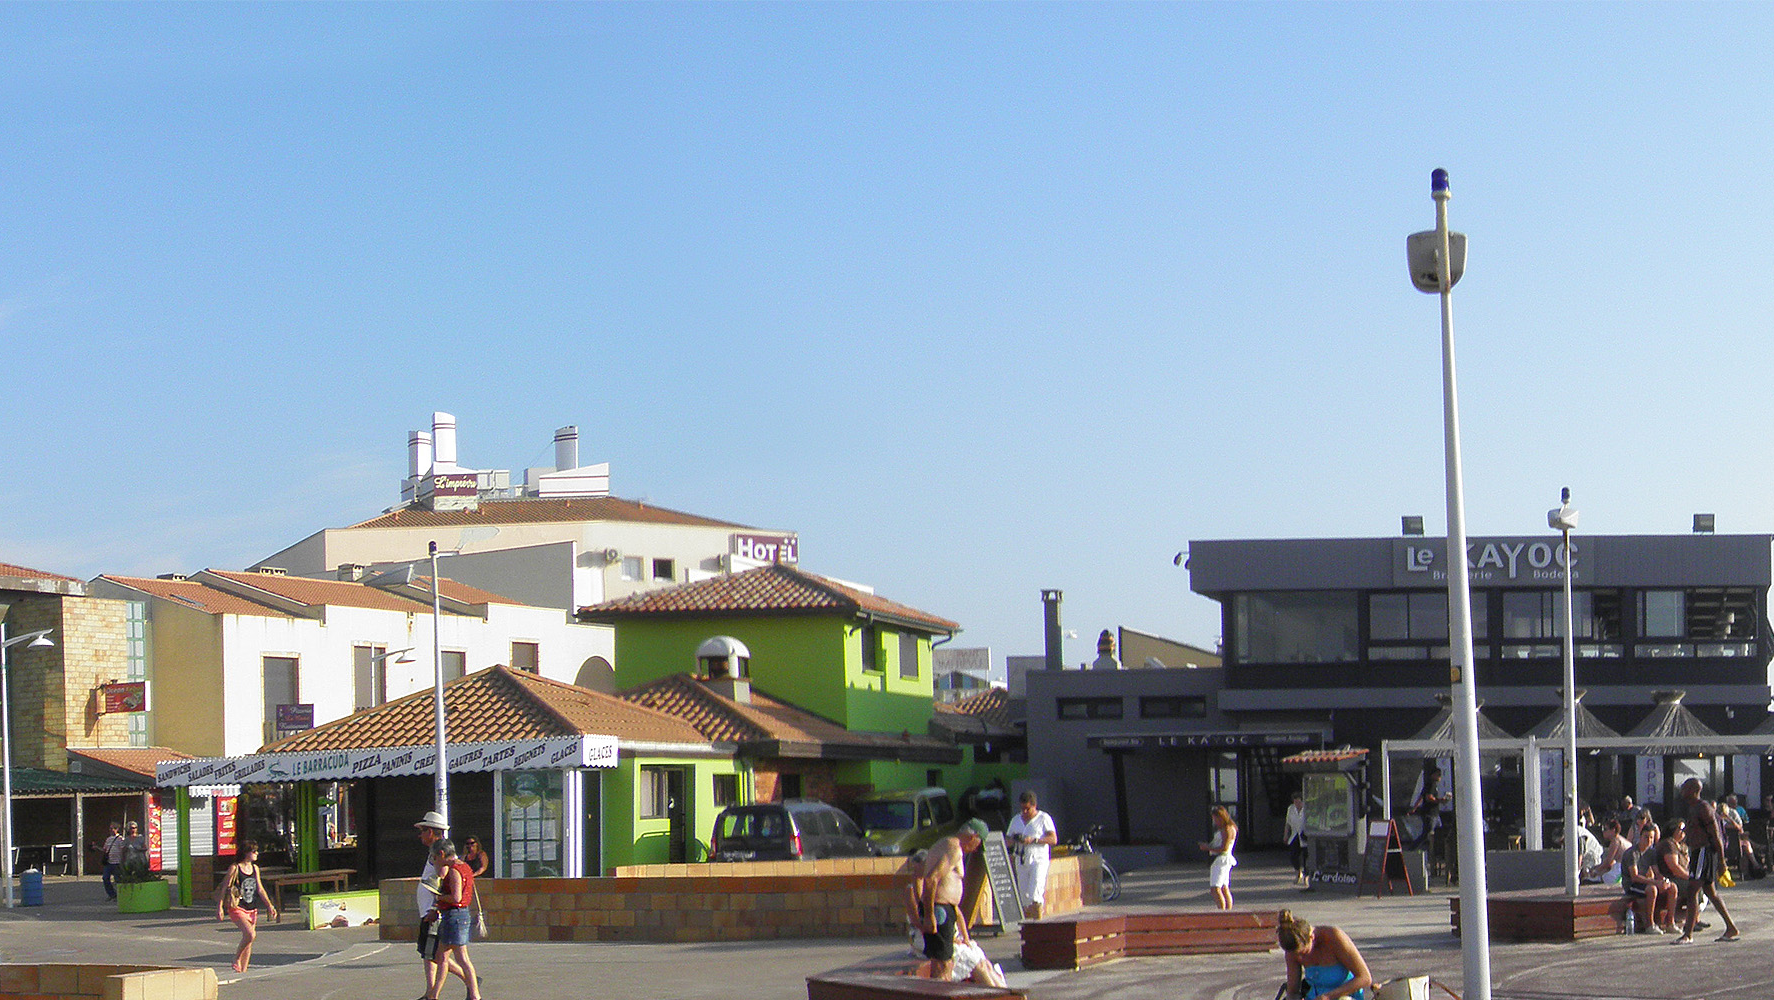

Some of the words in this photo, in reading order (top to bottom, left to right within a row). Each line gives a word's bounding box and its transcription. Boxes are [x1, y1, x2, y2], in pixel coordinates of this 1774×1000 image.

[1407, 546, 1434, 572] Le
[1533, 570, 1579, 580] Bodea
[187, 764, 214, 783] SALADES
[214, 761, 237, 781] FRITES
[233, 759, 266, 781] GRILLADES
[292, 762, 302, 777] LE
[302, 754, 350, 775] BARRACUDA
[351, 754, 382, 774] PIZZA
[381, 752, 414, 774] PANINIS
[448, 748, 484, 770] GAUFRES
[481, 746, 516, 768] TARTES
[513, 743, 546, 768] BEIGNETS
[550, 742, 578, 765] GLACES
[588, 745, 613, 762] GLACES
